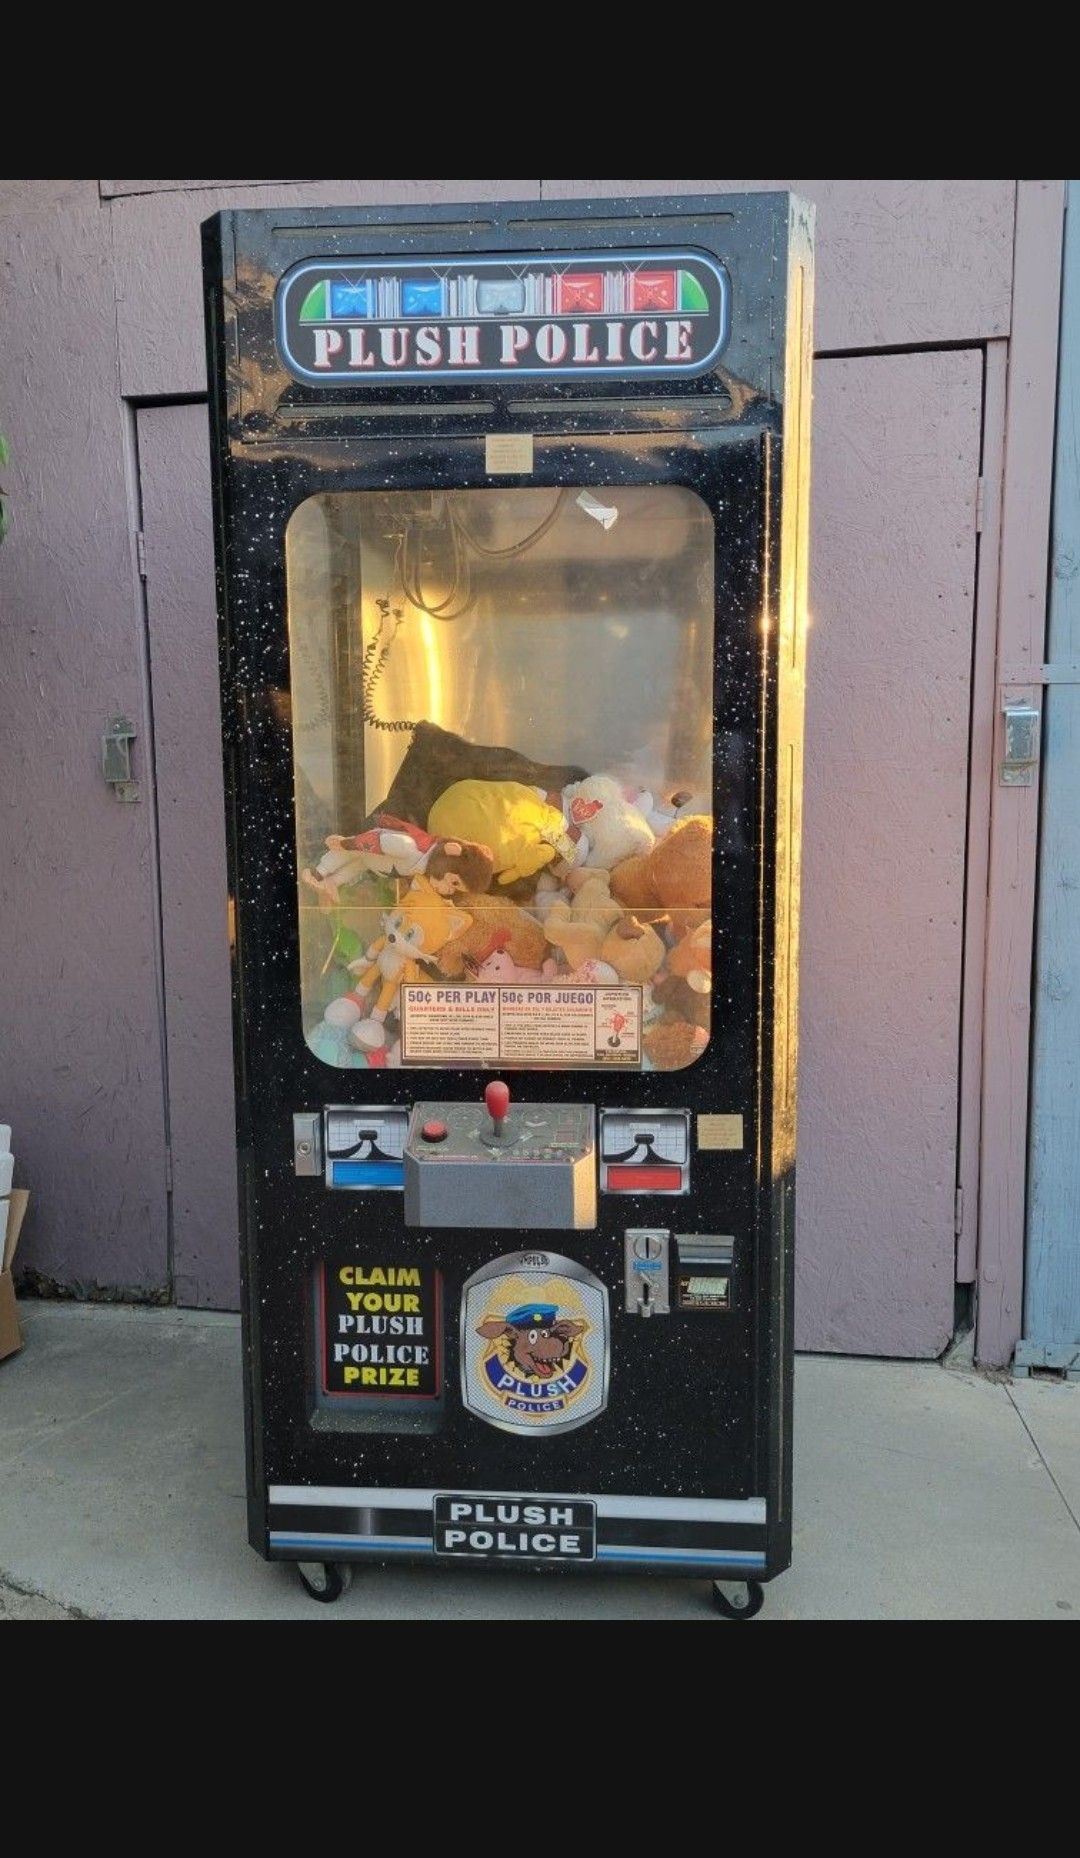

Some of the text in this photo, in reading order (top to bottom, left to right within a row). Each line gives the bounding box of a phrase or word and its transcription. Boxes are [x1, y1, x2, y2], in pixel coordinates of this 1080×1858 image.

[313, 320, 693, 369] PLUSH POLICE
[408, 990, 496, 1004] 50¢ PER PLAY
[502, 991, 524, 1004] 50¢
[528, 992, 551, 1004] POR
[555, 992, 594, 1004] JUEGO
[339, 1266, 421, 1287] CLAIM
[346, 1292, 420, 1312] YOUR
[338, 1314, 424, 1335] PLUSH
[333, 1343, 430, 1365] POLICE
[343, 1366, 420, 1386] PRIZE
[497, 1374, 577, 1397] PLUSH
[508, 1399, 561, 1411] POLICE
[450, 1503, 574, 1526] PLUSH
[445, 1530, 581, 1554] POLICE
